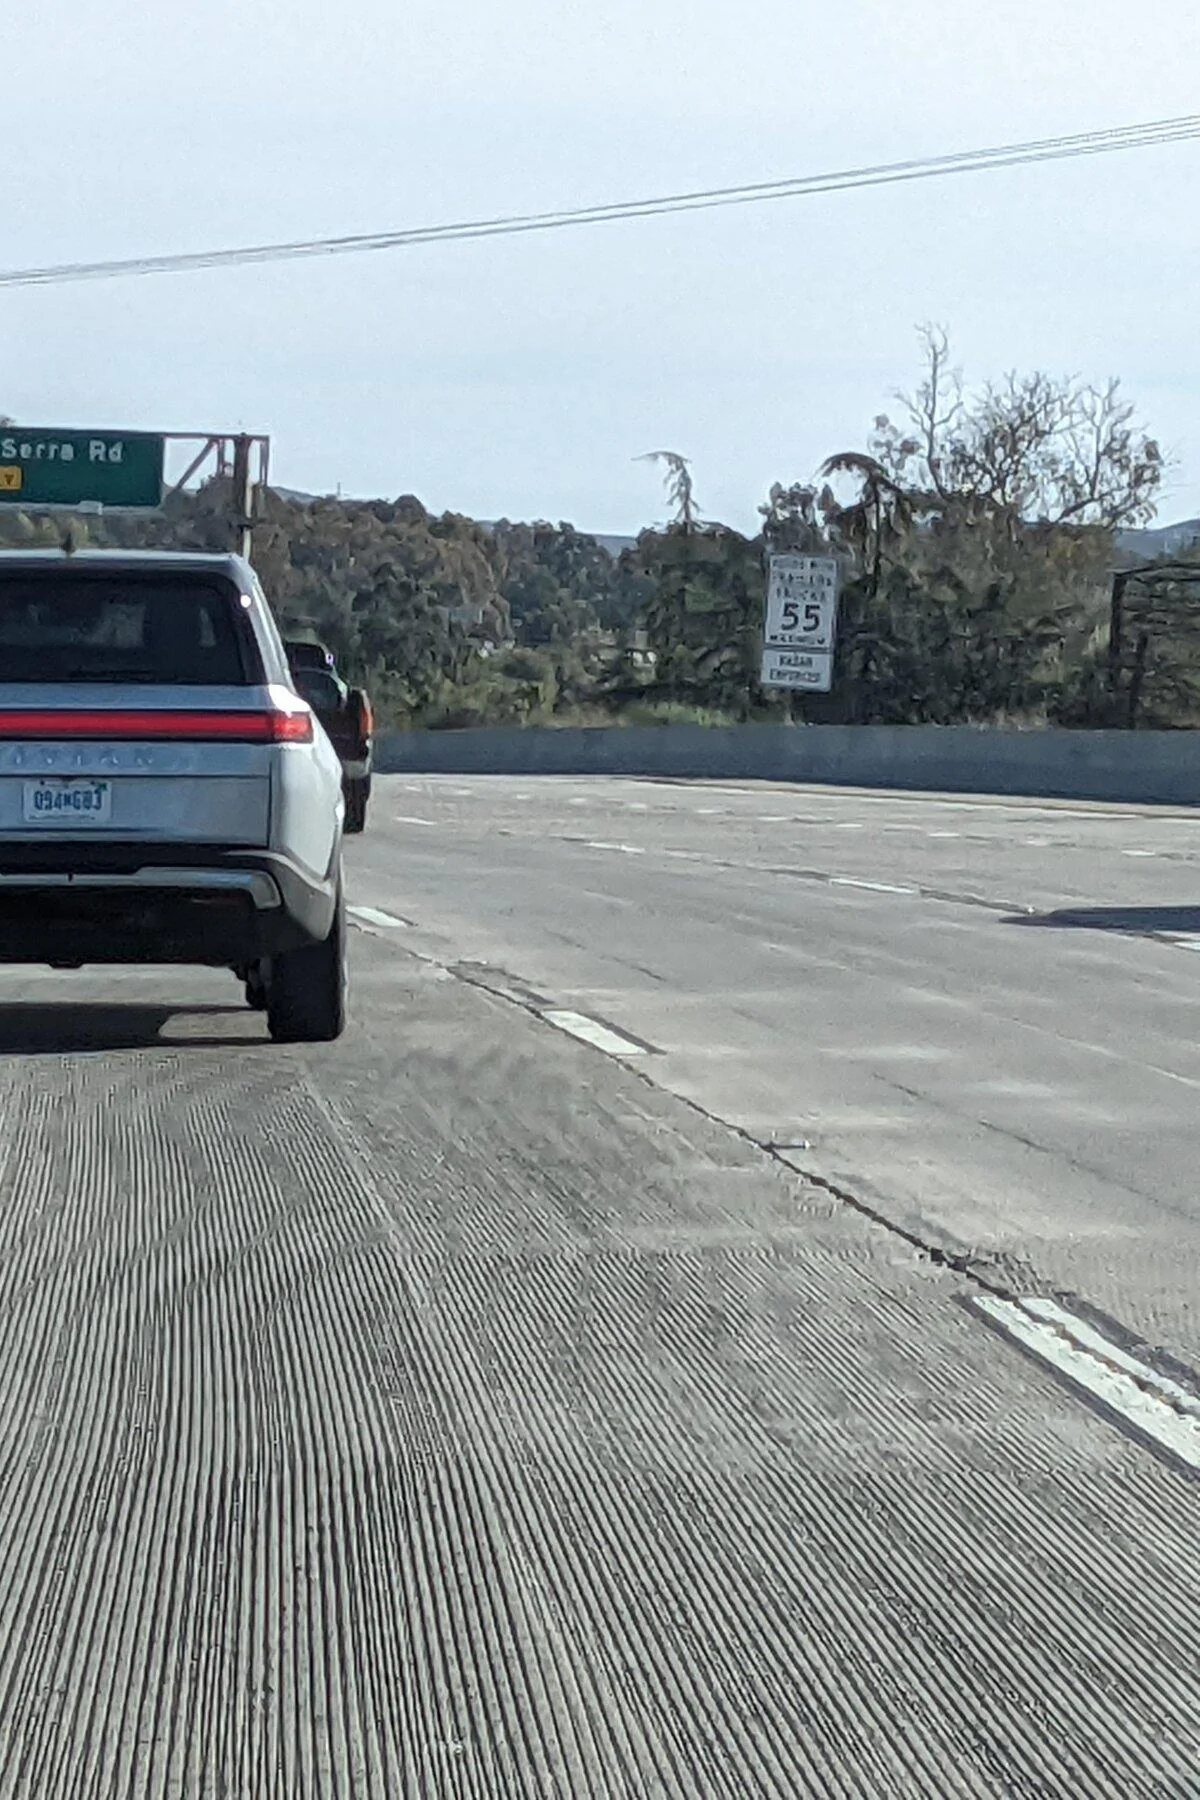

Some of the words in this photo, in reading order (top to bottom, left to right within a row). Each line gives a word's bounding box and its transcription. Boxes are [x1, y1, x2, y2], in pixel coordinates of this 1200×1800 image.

[1, 438, 75, 461] Serra
[88, 440, 125, 462] Rd
[781, 603, 820, 632] 55
